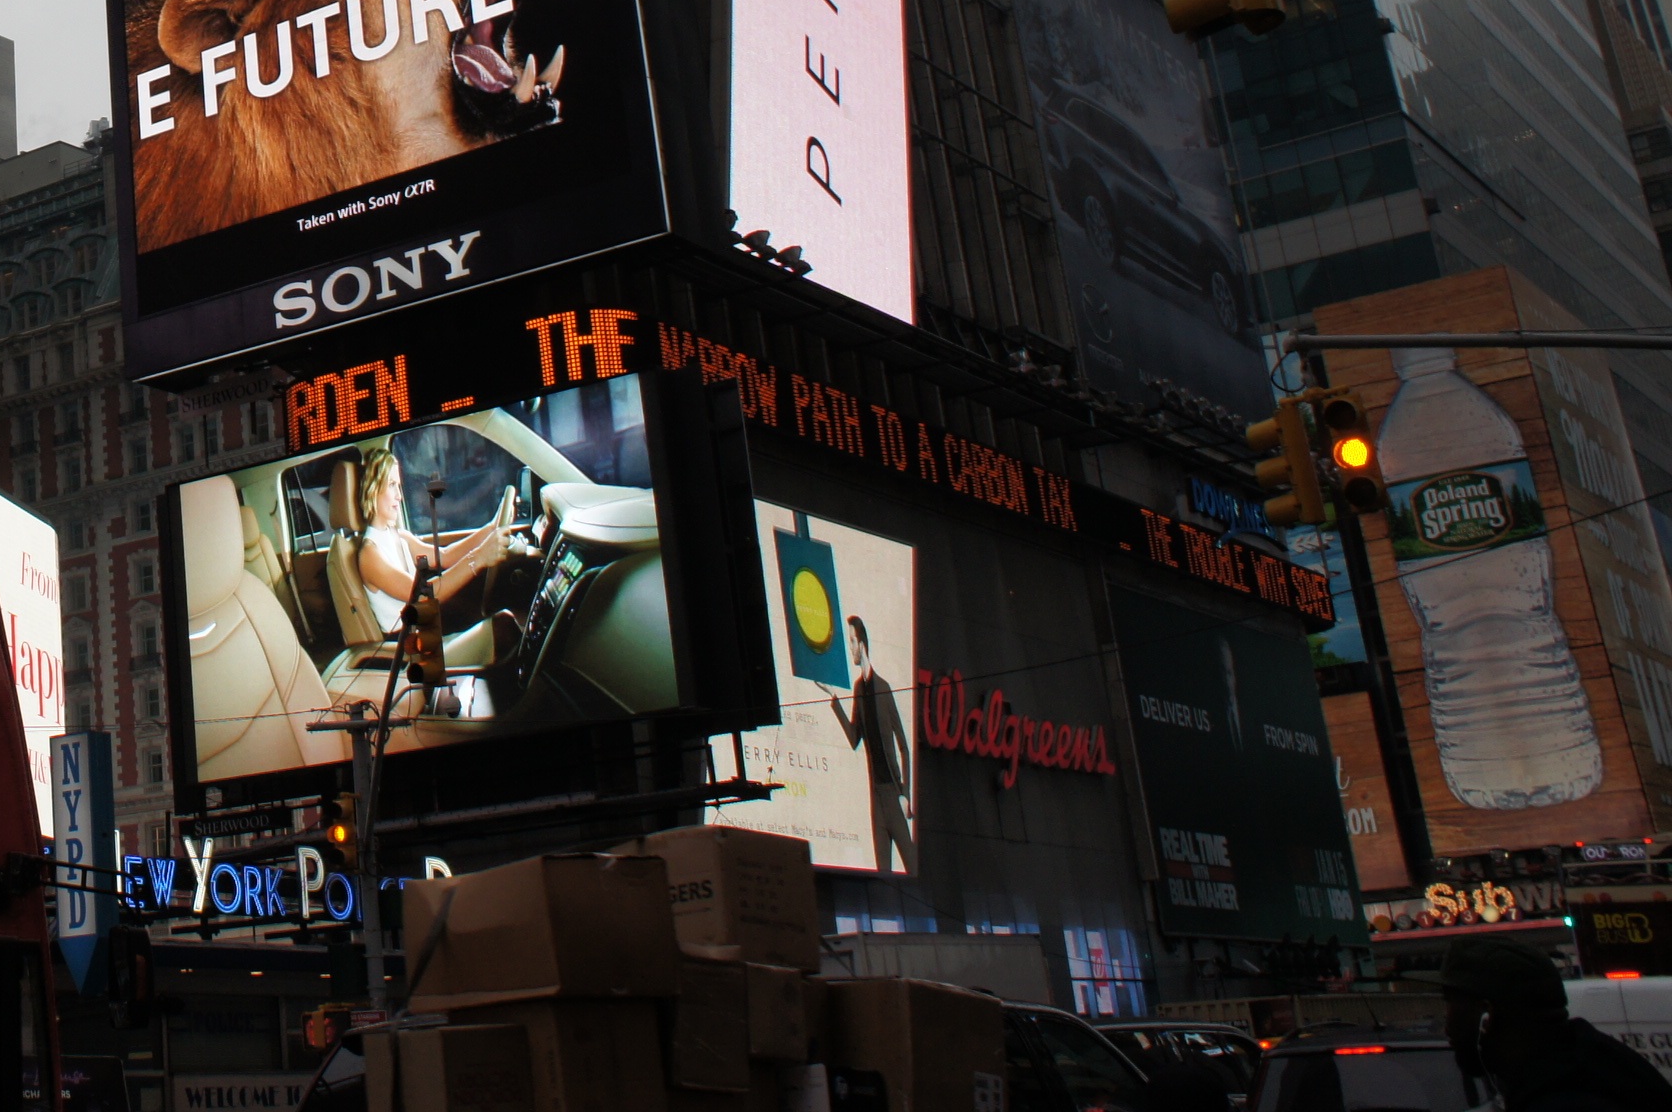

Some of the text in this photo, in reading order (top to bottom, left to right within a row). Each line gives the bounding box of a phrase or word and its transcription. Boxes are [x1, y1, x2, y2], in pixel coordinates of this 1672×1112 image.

[136, 63, 175, 140] E
[296, 209, 335, 232] Taken
[337, 200, 366, 221] with
[368, 191, 401, 214] Sony
[273, 230, 481, 329] SONY
[526, 308, 639, 386] THE
[791, 373, 865, 458] PATH
[870, 403, 908, 472] TO
[917, 422, 938, 484] A
[944, 433, 1029, 516] CARBON
[1032, 465, 1078, 533] TAX
[1420, 496, 1507, 540] Spring
[1422, 478, 1490, 508] Poland
[917, 667, 1117, 789] Walgreens
[1139, 693, 1320, 757] DELIVER US FROM SPIN
[788, 751, 829, 772] ELLIS
[60, 741, 87, 929] NYPD
[193, 814, 271, 837] SHERWOOD
[184, 836, 286, 916] YORK
[1592, 912, 1627, 929] BIG
[185, 1085, 281, 1109] WELCOME
